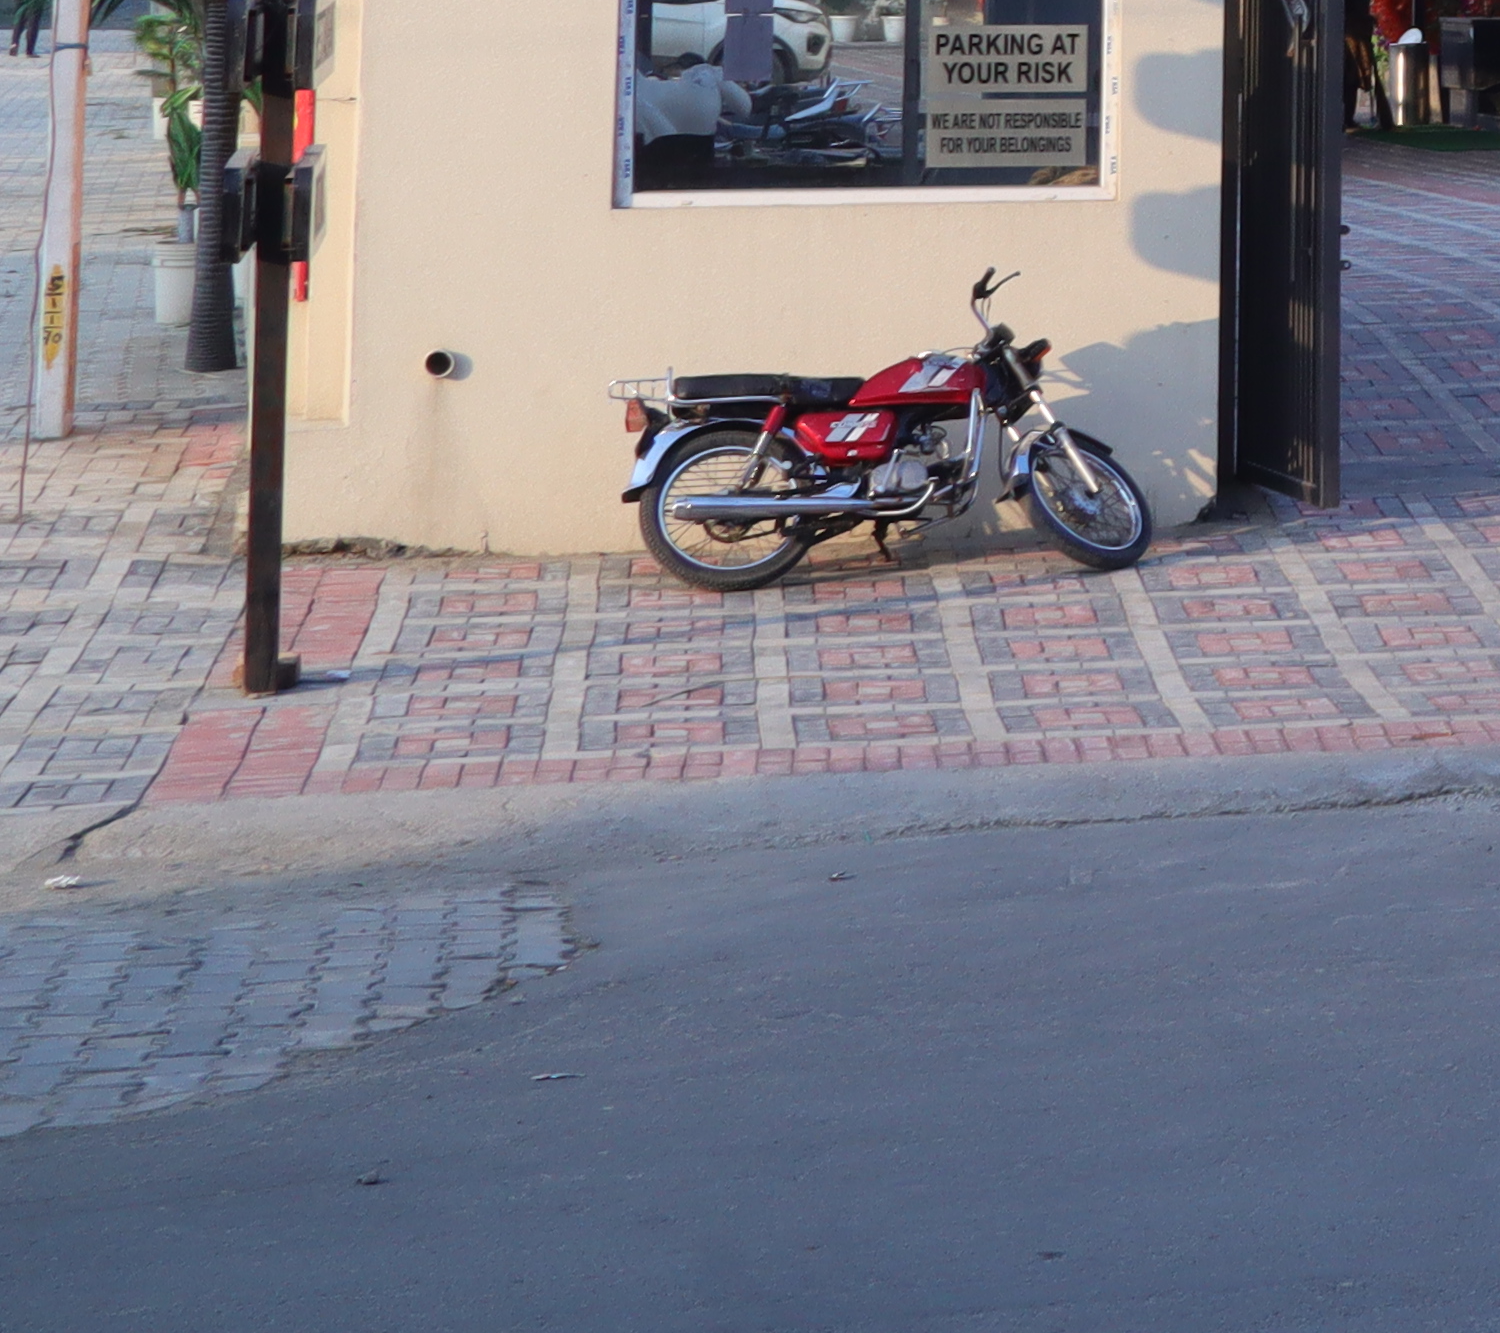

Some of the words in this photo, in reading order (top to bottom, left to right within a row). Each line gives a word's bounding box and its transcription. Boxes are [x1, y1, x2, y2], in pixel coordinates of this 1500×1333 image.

[935, 33, 1043, 55] PARKING
[1051, 33, 1081, 54] AT
[943, 62, 1009, 84] YOUR
[1017, 62, 1073, 83] RISK
[931, 113, 950, 129] WE
[952, 113, 977, 129] ARE
[979, 113, 1002, 129] NOT
[1004, 112, 1083, 129] RESPONSIBLE
[940, 137, 963, 154] FOR
[966, 137, 998, 153] YOUR
[999, 136, 1072, 153] BELONGINGS
